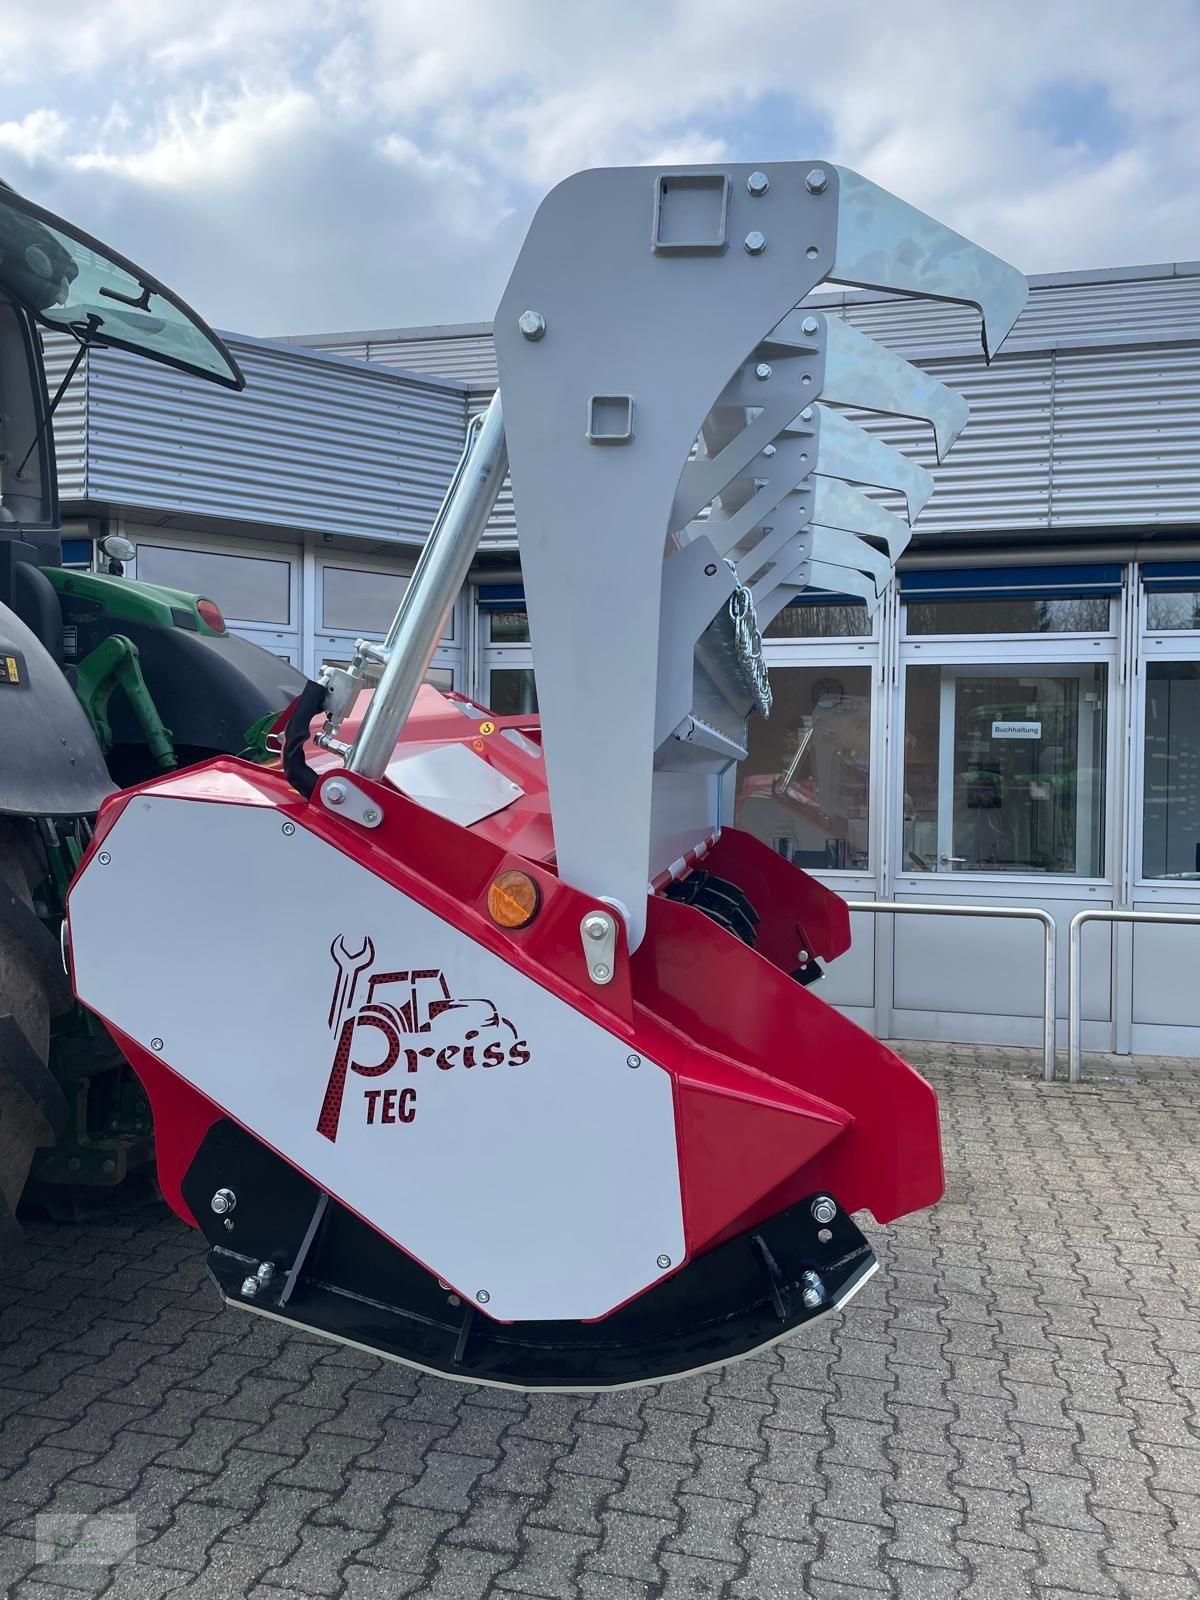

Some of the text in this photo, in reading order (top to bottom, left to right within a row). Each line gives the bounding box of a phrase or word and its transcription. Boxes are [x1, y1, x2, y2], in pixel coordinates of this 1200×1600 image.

[995, 726, 1039, 735] Buchhaltung
[316, 1015, 531, 1144] Preiss
[364, 1088, 417, 1125] TEC
